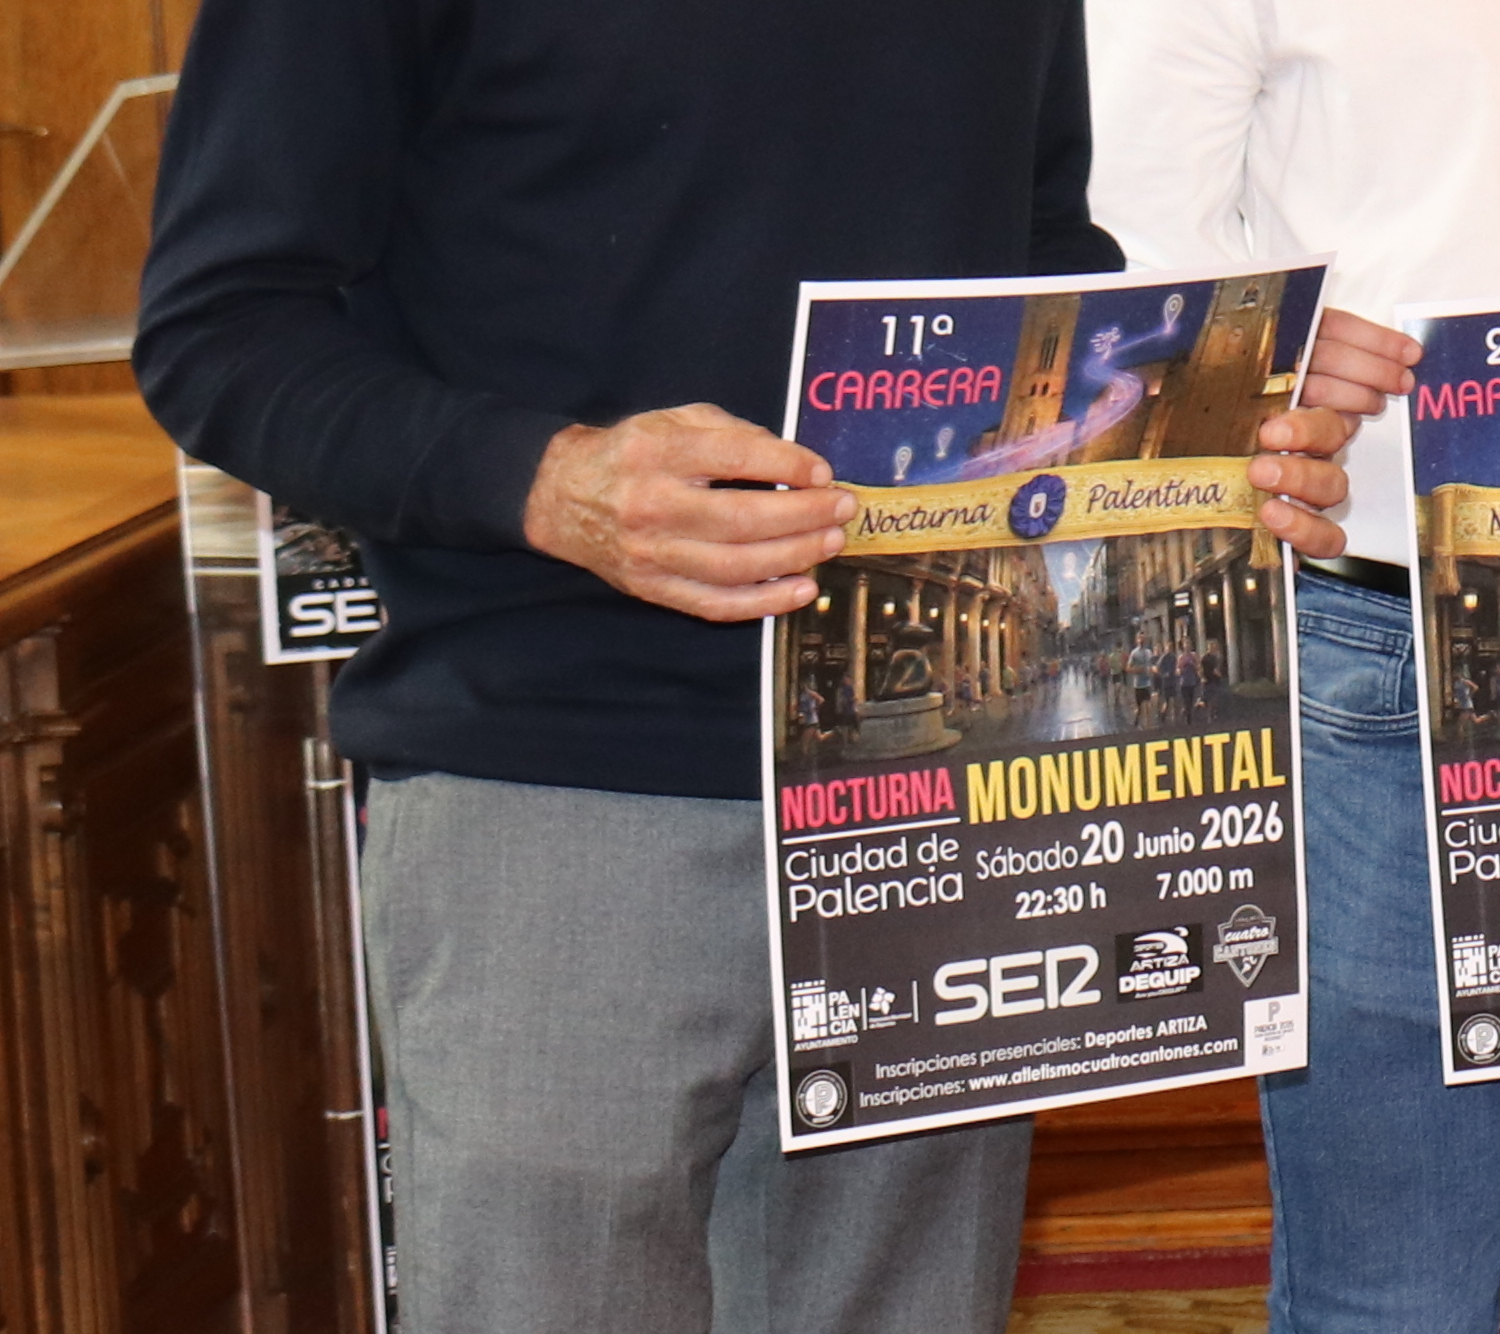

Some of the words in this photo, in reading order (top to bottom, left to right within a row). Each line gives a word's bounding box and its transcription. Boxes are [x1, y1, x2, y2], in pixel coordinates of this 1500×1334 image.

[880, 315, 954, 361] 11ª
[808, 363, 1002, 413] CARRERA
[858, 503, 992, 535] Nocturna
[1086, 479, 1227, 513] Palentina
[780, 767, 955, 831] NOCTURNA
[967, 728, 1284, 824] MONUMENTAL
[782, 836, 907, 881] Ciudad
[916, 832, 959, 864] de
[975, 839, 1077, 879] Sábado
[1080, 819, 1124, 865] 20
[1133, 824, 1194, 859] Junio
[1200, 800, 1282, 851] 2026
[786, 866, 962, 918] Palencia
[1015, 885, 1083, 919] 22:30
[1090, 881, 1106, 909] h
[1156, 866, 1222, 901] 7.000
[1229, 867, 1253, 890] m
[934, 945, 1099, 1024] SER
[1118, 965, 1200, 992] DEQUIP
[875, 1052, 976, 1079] Inscripciones
[980, 1036, 1080, 1067] presenciales:
[1084, 1024, 1152, 1048] Deportes
[1156, 1014, 1207, 1037] ARTIZA
[859, 1079, 964, 1108] Inscripciones:
[968, 1038, 1237, 1090] www.atletismocuatrocantones.com
